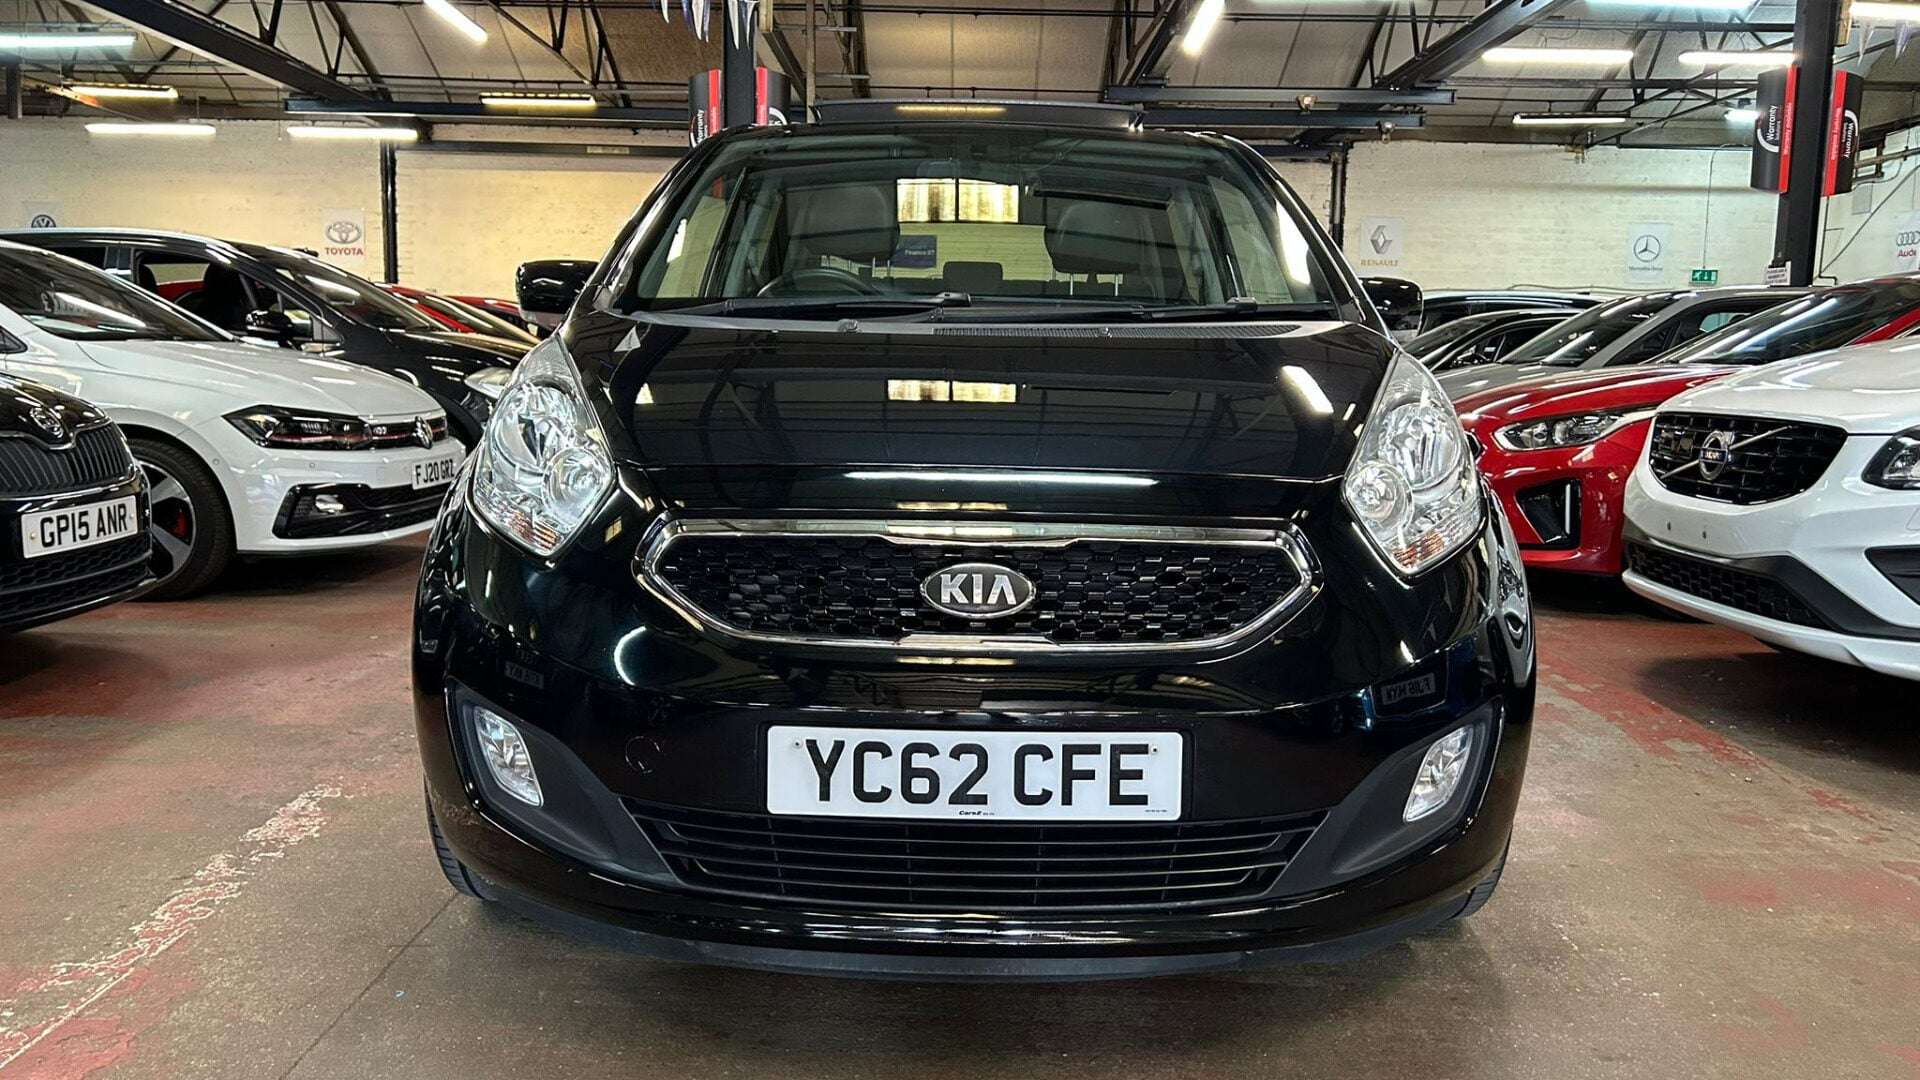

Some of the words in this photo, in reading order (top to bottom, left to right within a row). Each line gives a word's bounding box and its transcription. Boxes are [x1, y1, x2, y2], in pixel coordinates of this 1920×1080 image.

[1766, 105, 1778, 140] Warranty
[1843, 122, 1854, 158] Warranty
[324, 247, 364, 256] TOYOTA
[1896, 249, 1917, 257] Audi
[40, 511, 90, 548] GP15
[96, 503, 128, 538] ANR
[940, 573, 1017, 605] KIA
[805, 739, 988, 805] YC62
[1014, 744, 1149, 806] CFE
